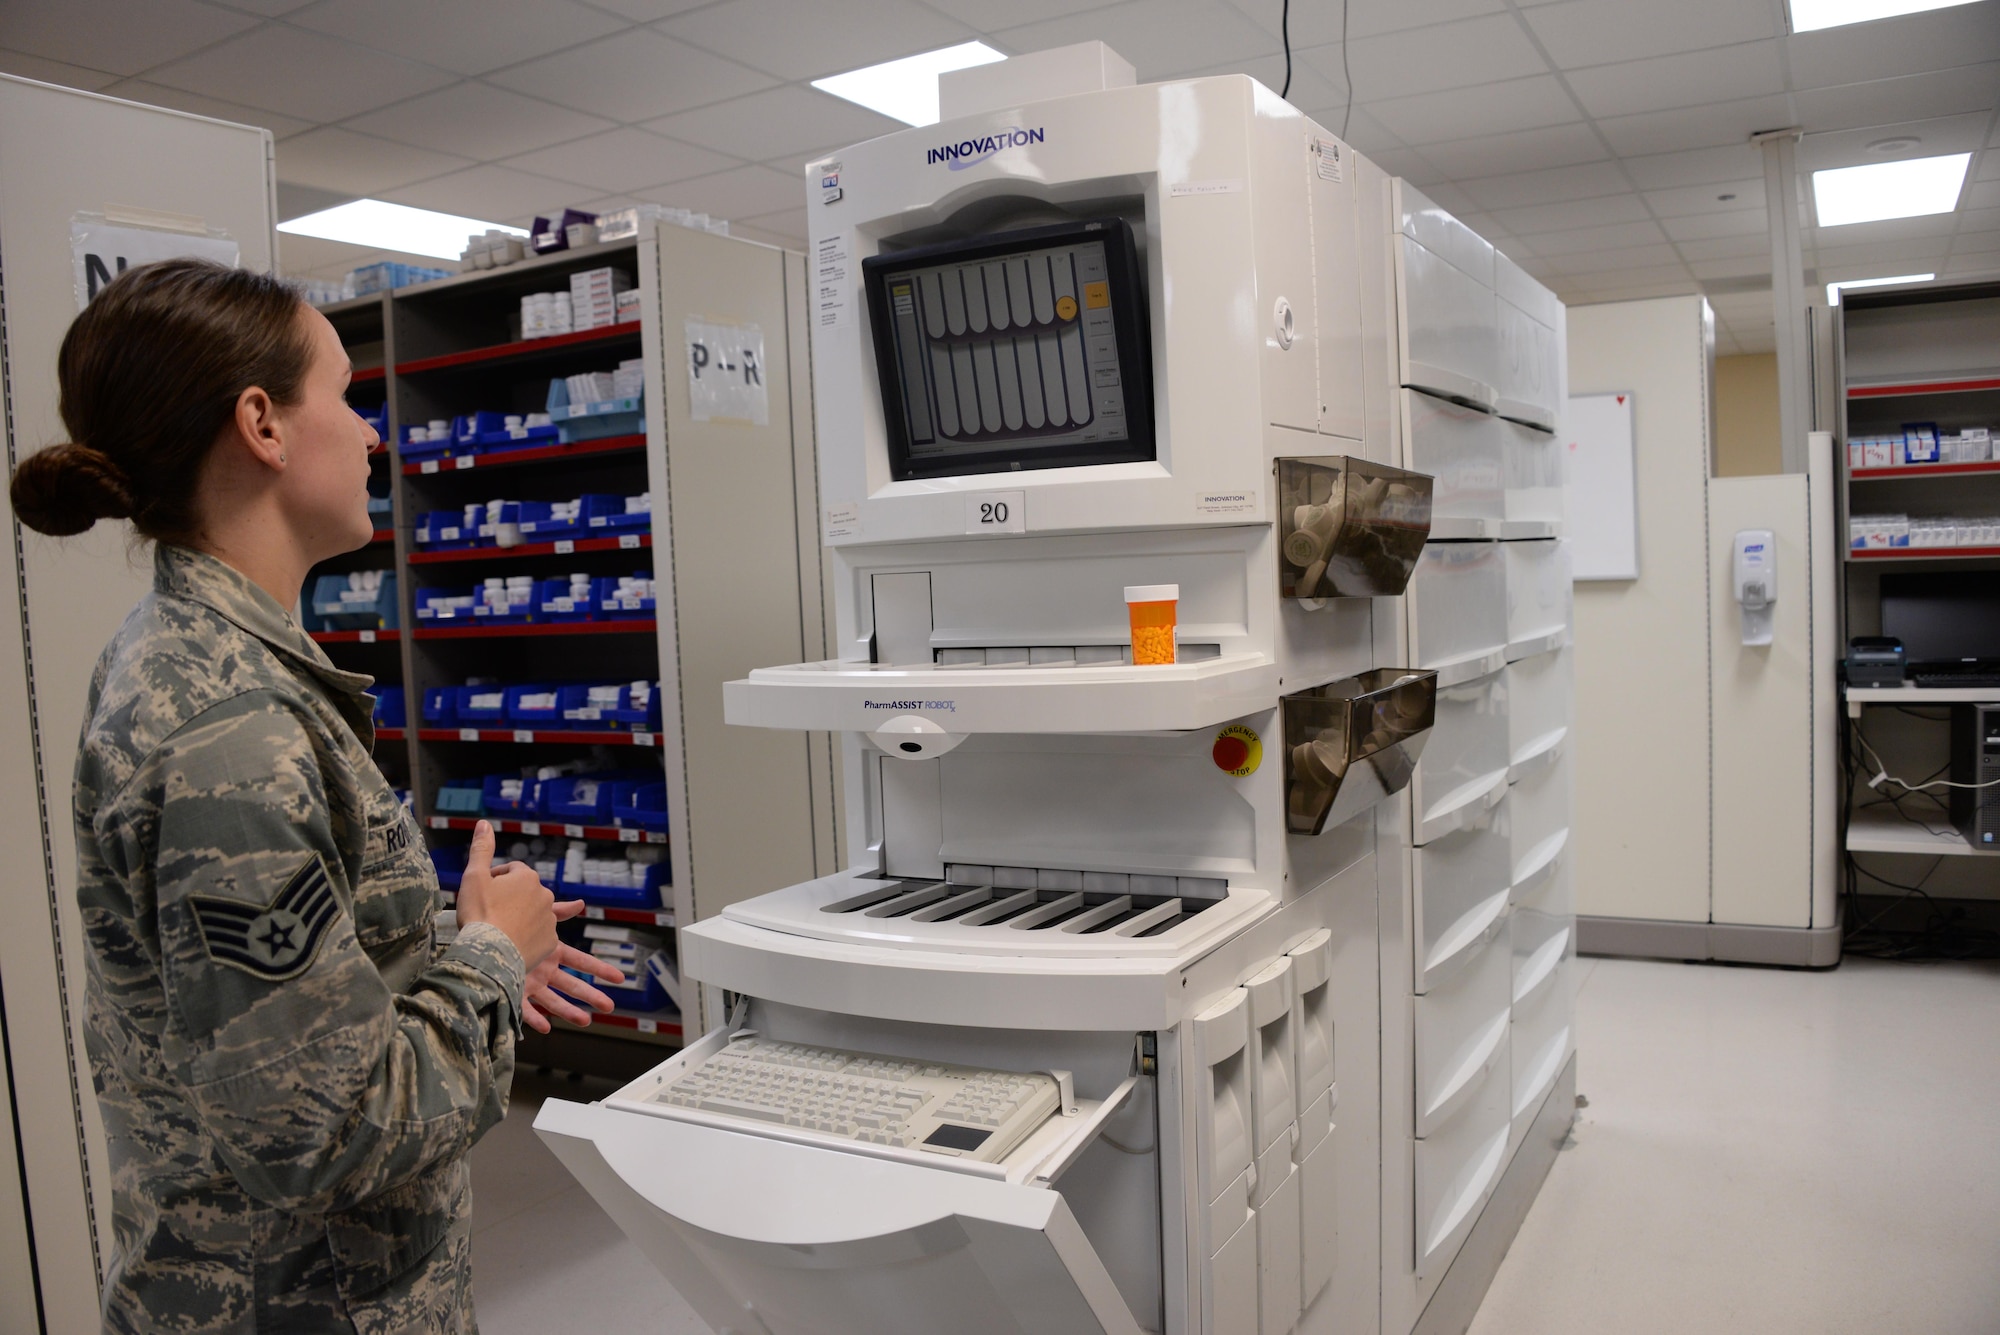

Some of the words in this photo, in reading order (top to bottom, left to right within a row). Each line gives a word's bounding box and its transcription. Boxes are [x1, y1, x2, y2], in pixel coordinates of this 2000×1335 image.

[927, 127, 1044, 165] INNOVATION
[692, 343, 709, 379] P
[743, 350, 761, 386] R
[1204, 495, 1245, 503] INNOVATION
[980, 502, 1009, 524] 20
[864, 700, 923, 710] PharmASSIST
[1218, 726, 1258, 742] MERGENCY
